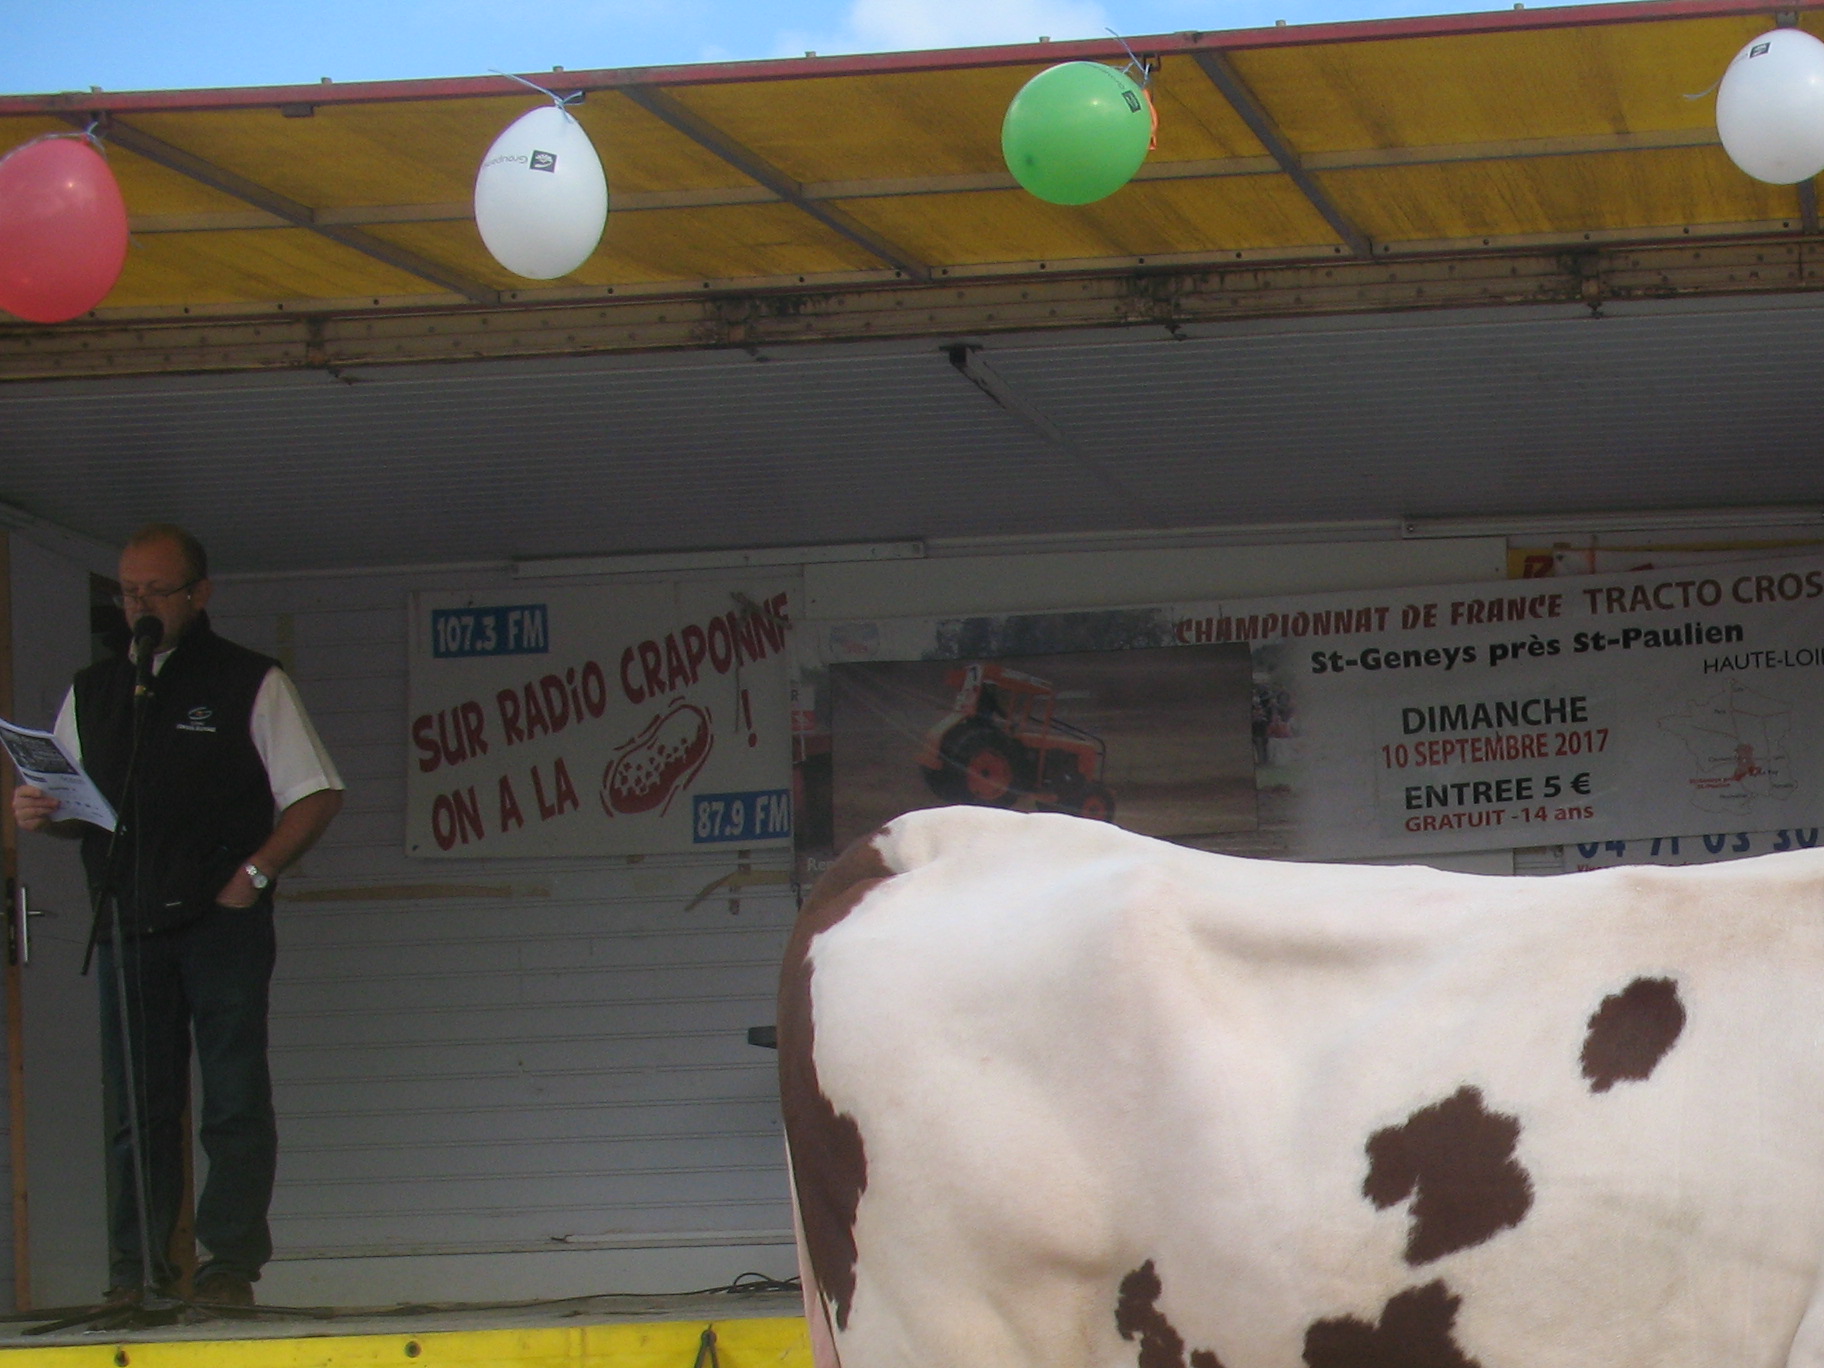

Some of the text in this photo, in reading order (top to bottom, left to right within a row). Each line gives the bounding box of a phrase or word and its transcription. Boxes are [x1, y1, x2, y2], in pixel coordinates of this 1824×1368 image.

[437, 609, 545, 653] 107.3 FM
[1175, 606, 1389, 645] CHAMPIONNAT
[1402, 602, 1438, 630] DE
[1451, 593, 1562, 626] FRANCE
[1583, 578, 1722, 615] TRACTO
[1311, 622, 1744, 674] St-Geneys près St-Paulien
[412, 700, 488, 773] SUR
[619, 592, 789, 704] CRAPONNE
[1402, 697, 1588, 735] DIMANCHE
[1382, 728, 1609, 769] 10 SEPTEMBRE 2017
[432, 785, 485, 851] ON
[501, 775, 524, 833] A
[531, 757, 580, 821] LA
[1405, 772, 1592, 811] ENTREE 5 €
[698, 794, 788, 838] 87.9 FM
[1405, 805, 1594, 833] GRATUIT -14 ans
